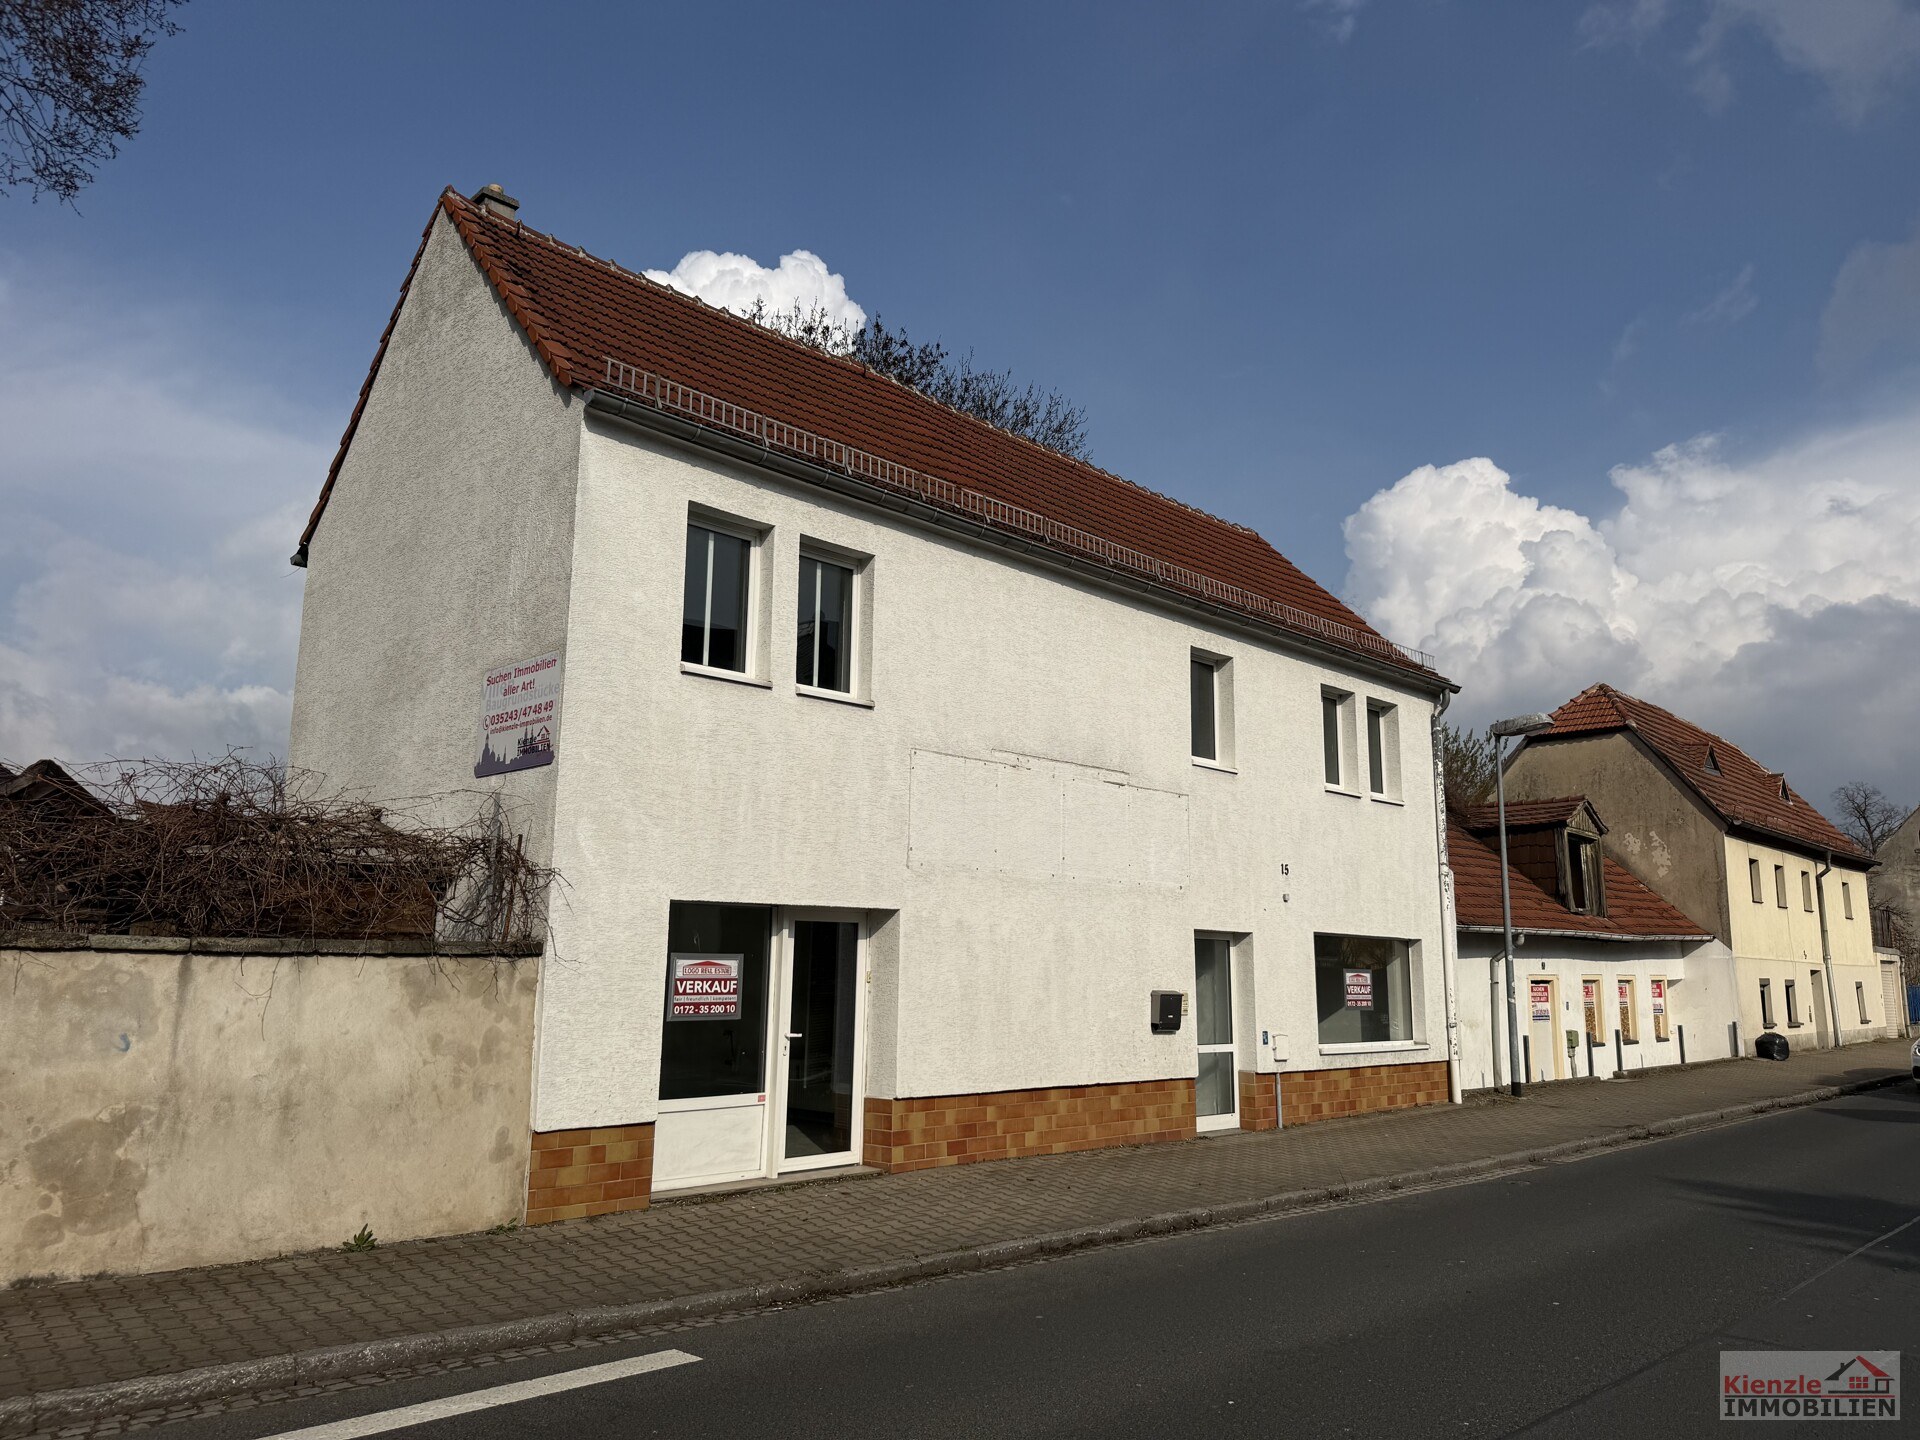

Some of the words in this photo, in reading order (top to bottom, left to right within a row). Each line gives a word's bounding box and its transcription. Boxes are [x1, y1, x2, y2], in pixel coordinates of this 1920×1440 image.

[486, 672, 512, 686] Suchen
[514, 658, 557, 678] Immobilien
[502, 684, 519, 697] aller
[521, 678, 536, 692] Art!
[1280, 863, 1290, 876] 15
[676, 980, 738, 994] VERKAUF
[1346, 985, 1371, 994] VERKAUF
[674, 1006, 694, 1014] 0172
[710, 1004, 724, 1013] 200
[726, 1004, 736, 1012] 10
